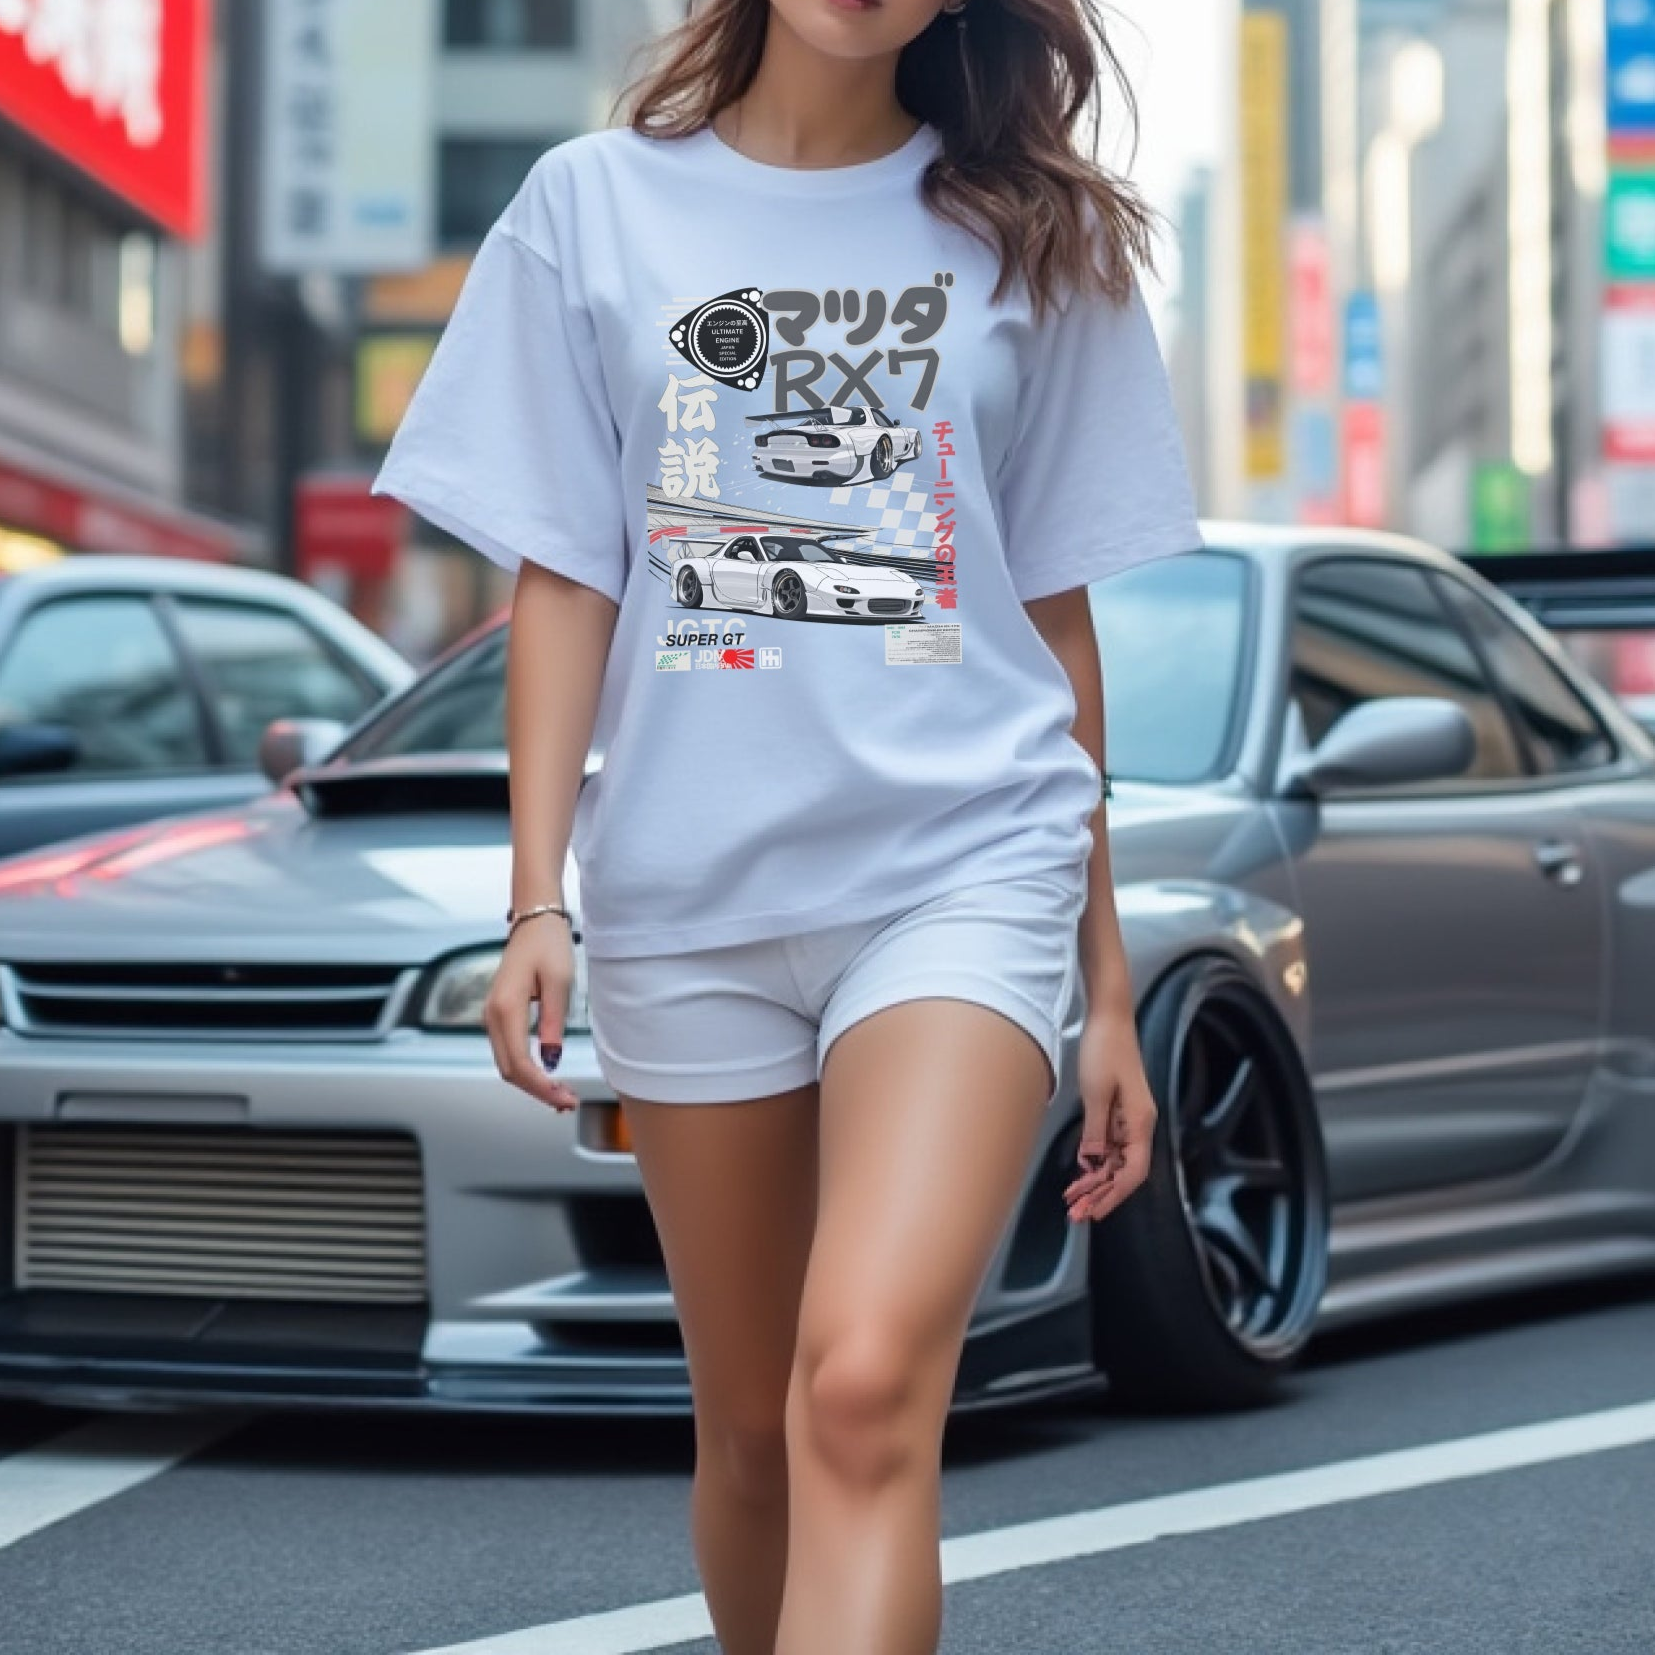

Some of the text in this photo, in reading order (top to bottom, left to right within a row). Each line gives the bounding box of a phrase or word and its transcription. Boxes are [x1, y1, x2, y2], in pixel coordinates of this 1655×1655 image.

[761, 272, 955, 346] マツダ
[769, 347, 940, 412] RX7
[657, 372, 721, 498] 伝説
[931, 420, 958, 610] チューニングの王者
[657, 618, 746, 646] JGTC
[666, 632, 745, 646] SUPER GT
